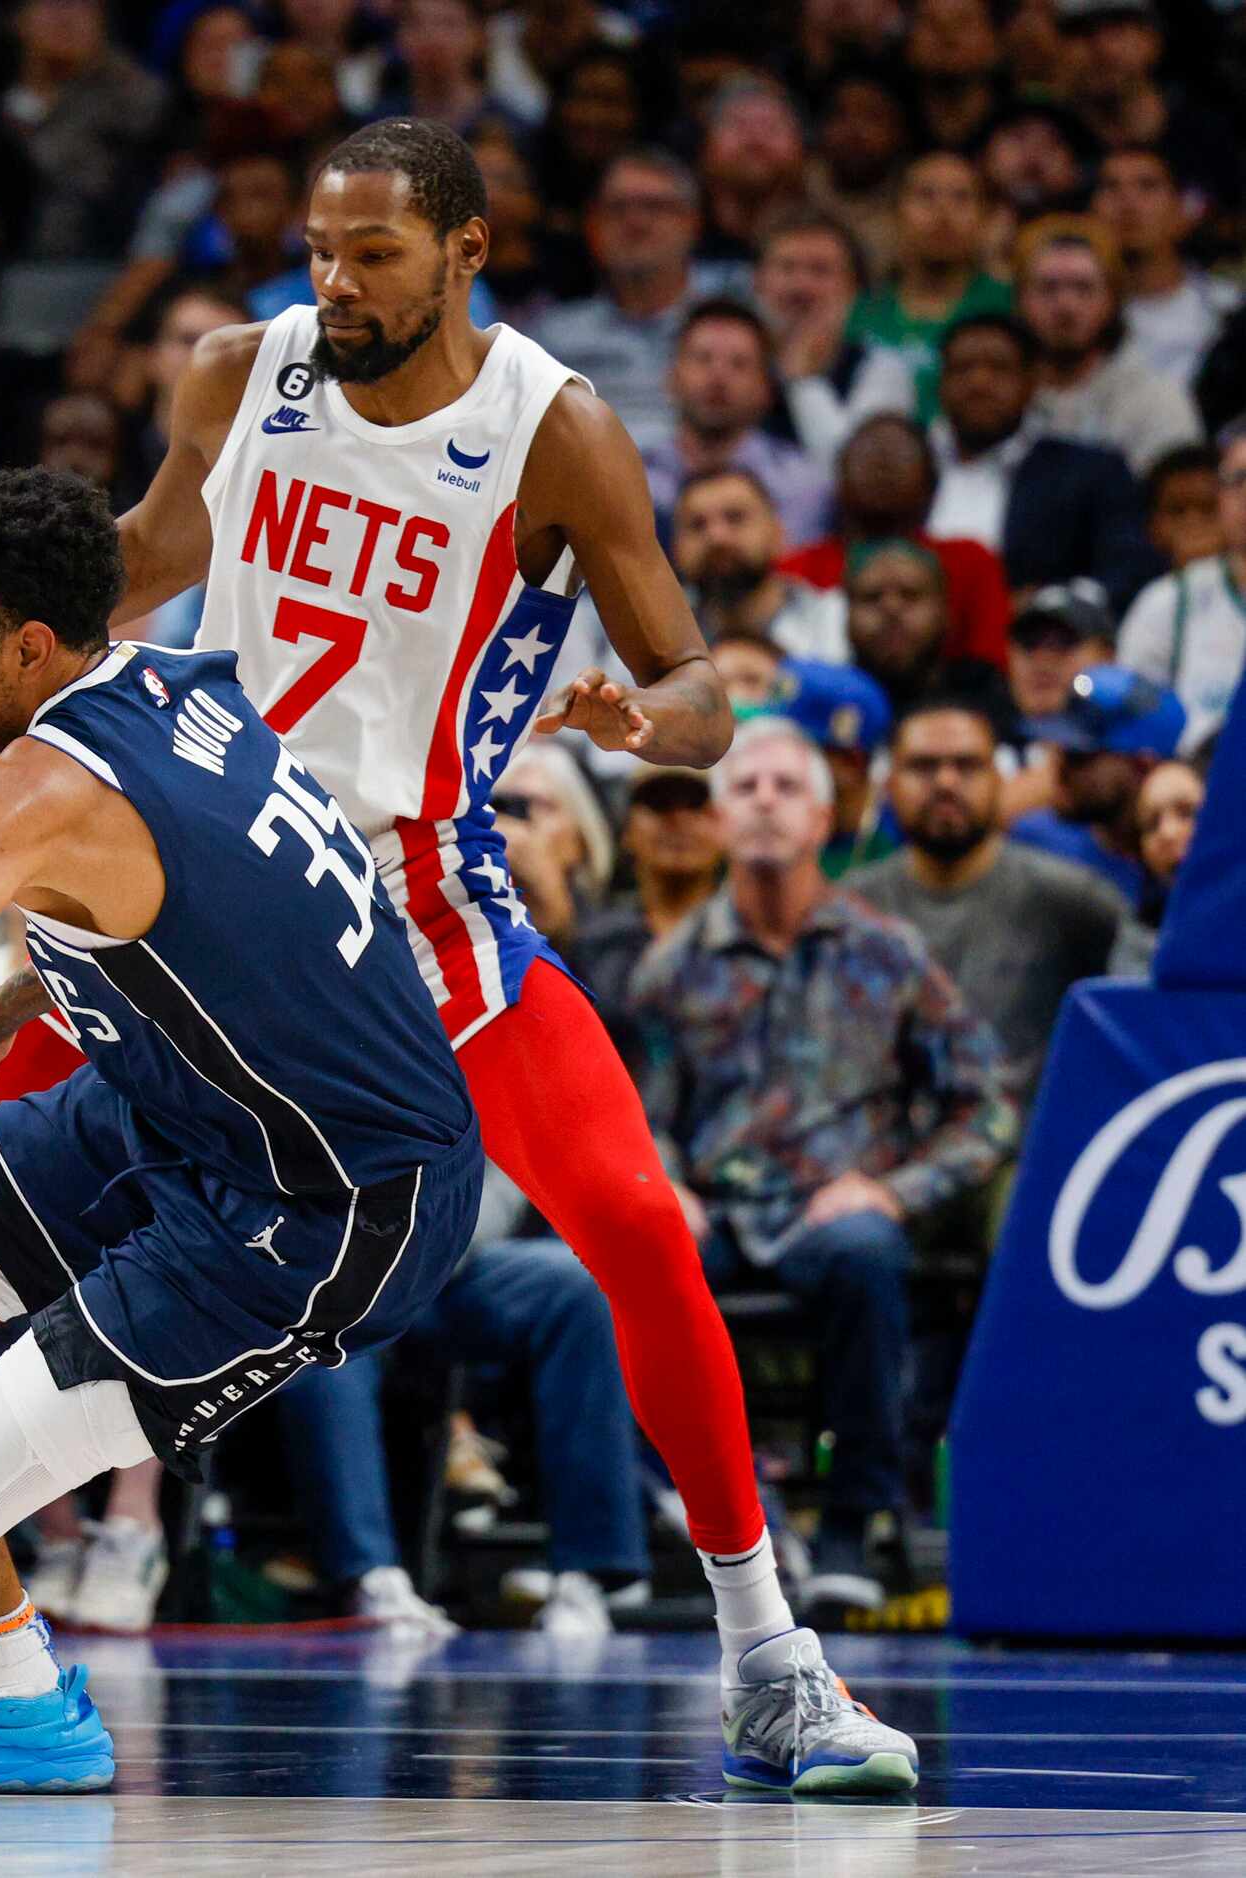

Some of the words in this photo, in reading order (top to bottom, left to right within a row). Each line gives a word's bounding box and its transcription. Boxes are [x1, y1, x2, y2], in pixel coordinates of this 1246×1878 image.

[270, 404, 310, 426] NIKE
[437, 468, 481, 493] Webull
[240, 469, 451, 613] NETS
[261, 596, 368, 736] 7
[172, 688, 243, 776] WOOD
[247, 743, 376, 969] 35
